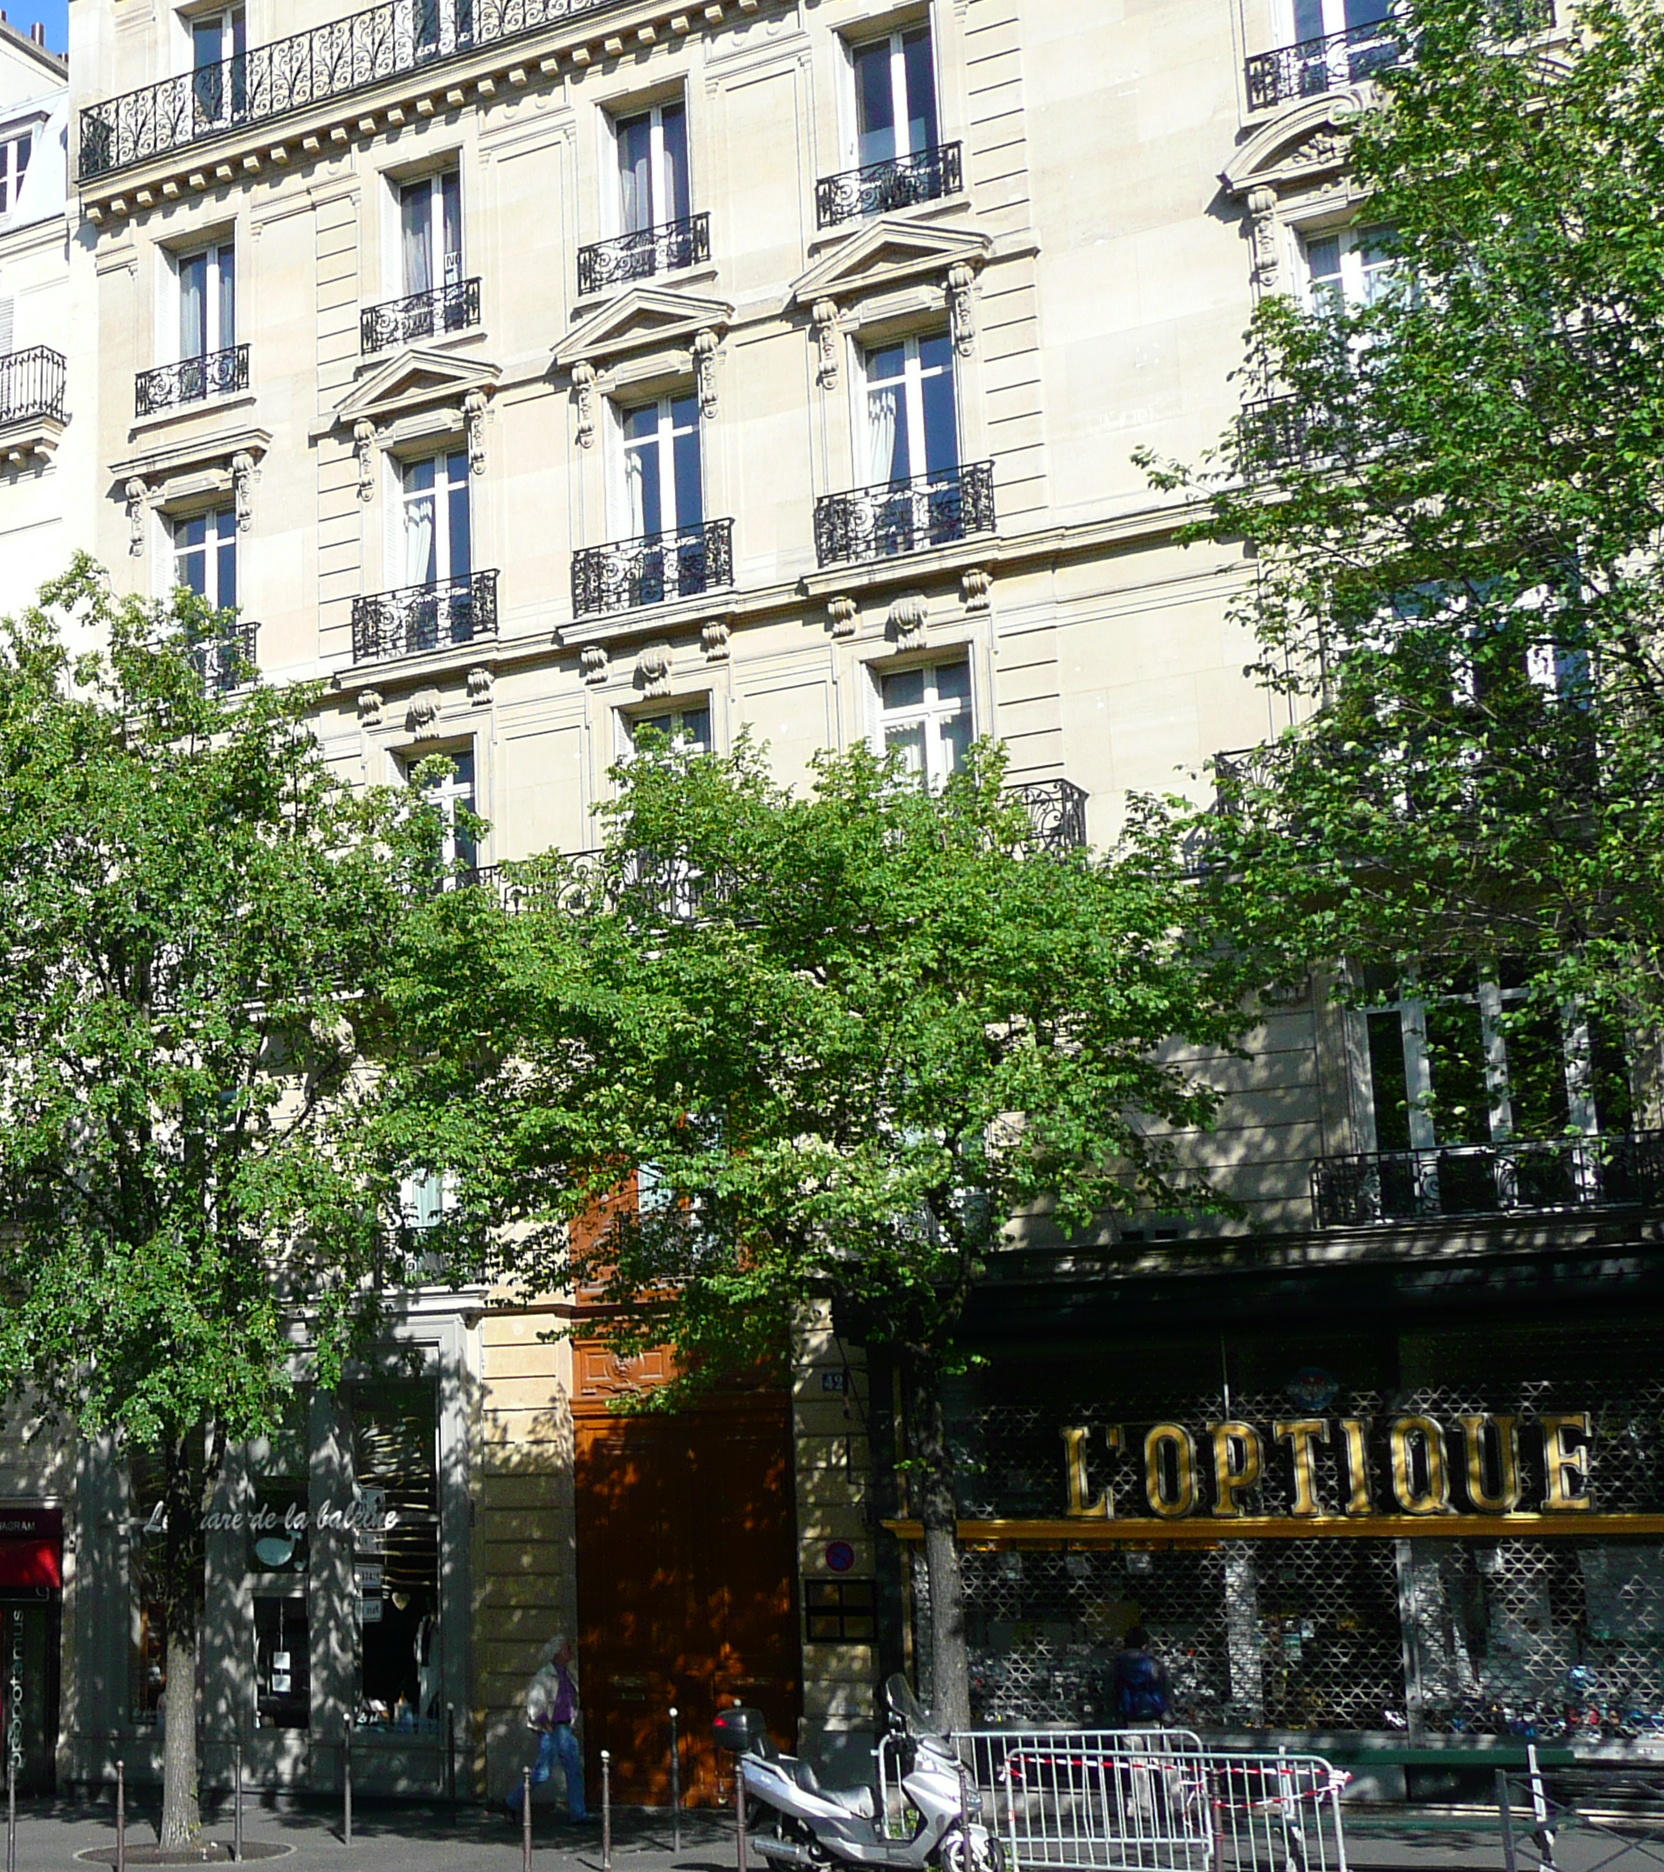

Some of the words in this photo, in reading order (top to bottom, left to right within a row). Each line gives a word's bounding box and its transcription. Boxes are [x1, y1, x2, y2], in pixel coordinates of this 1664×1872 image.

[1059, 1411, 1596, 1519] L'OPTIQUE
[249, 1502, 277, 1530] de
[284, 1501, 309, 1530] la
